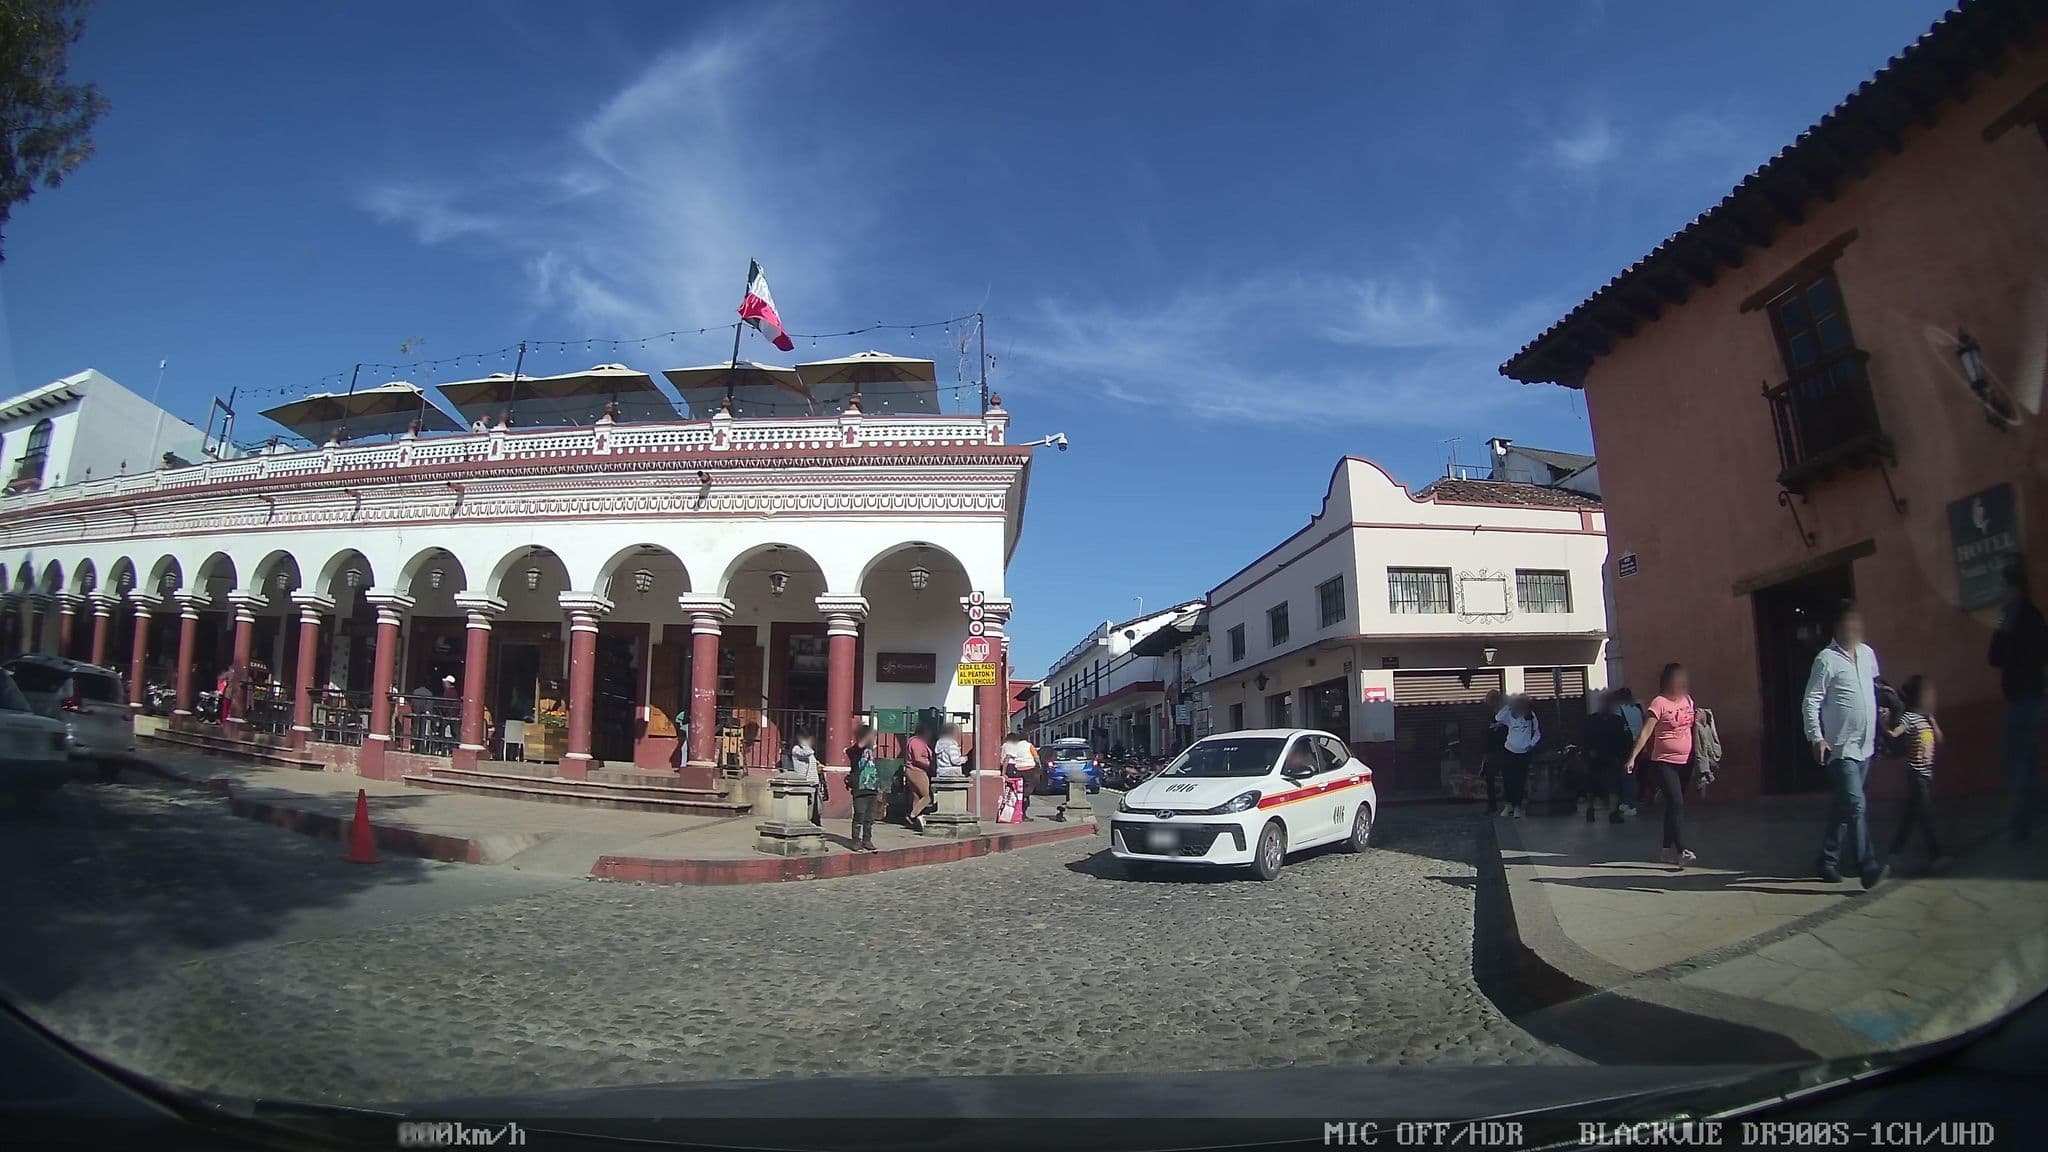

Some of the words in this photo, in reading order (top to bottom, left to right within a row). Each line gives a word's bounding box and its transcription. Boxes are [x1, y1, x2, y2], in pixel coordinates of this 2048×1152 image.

[1957, 532, 2017, 562] HOTEL
[965, 643, 988, 655] ALTO
[1166, 783, 1198, 793] 0916
